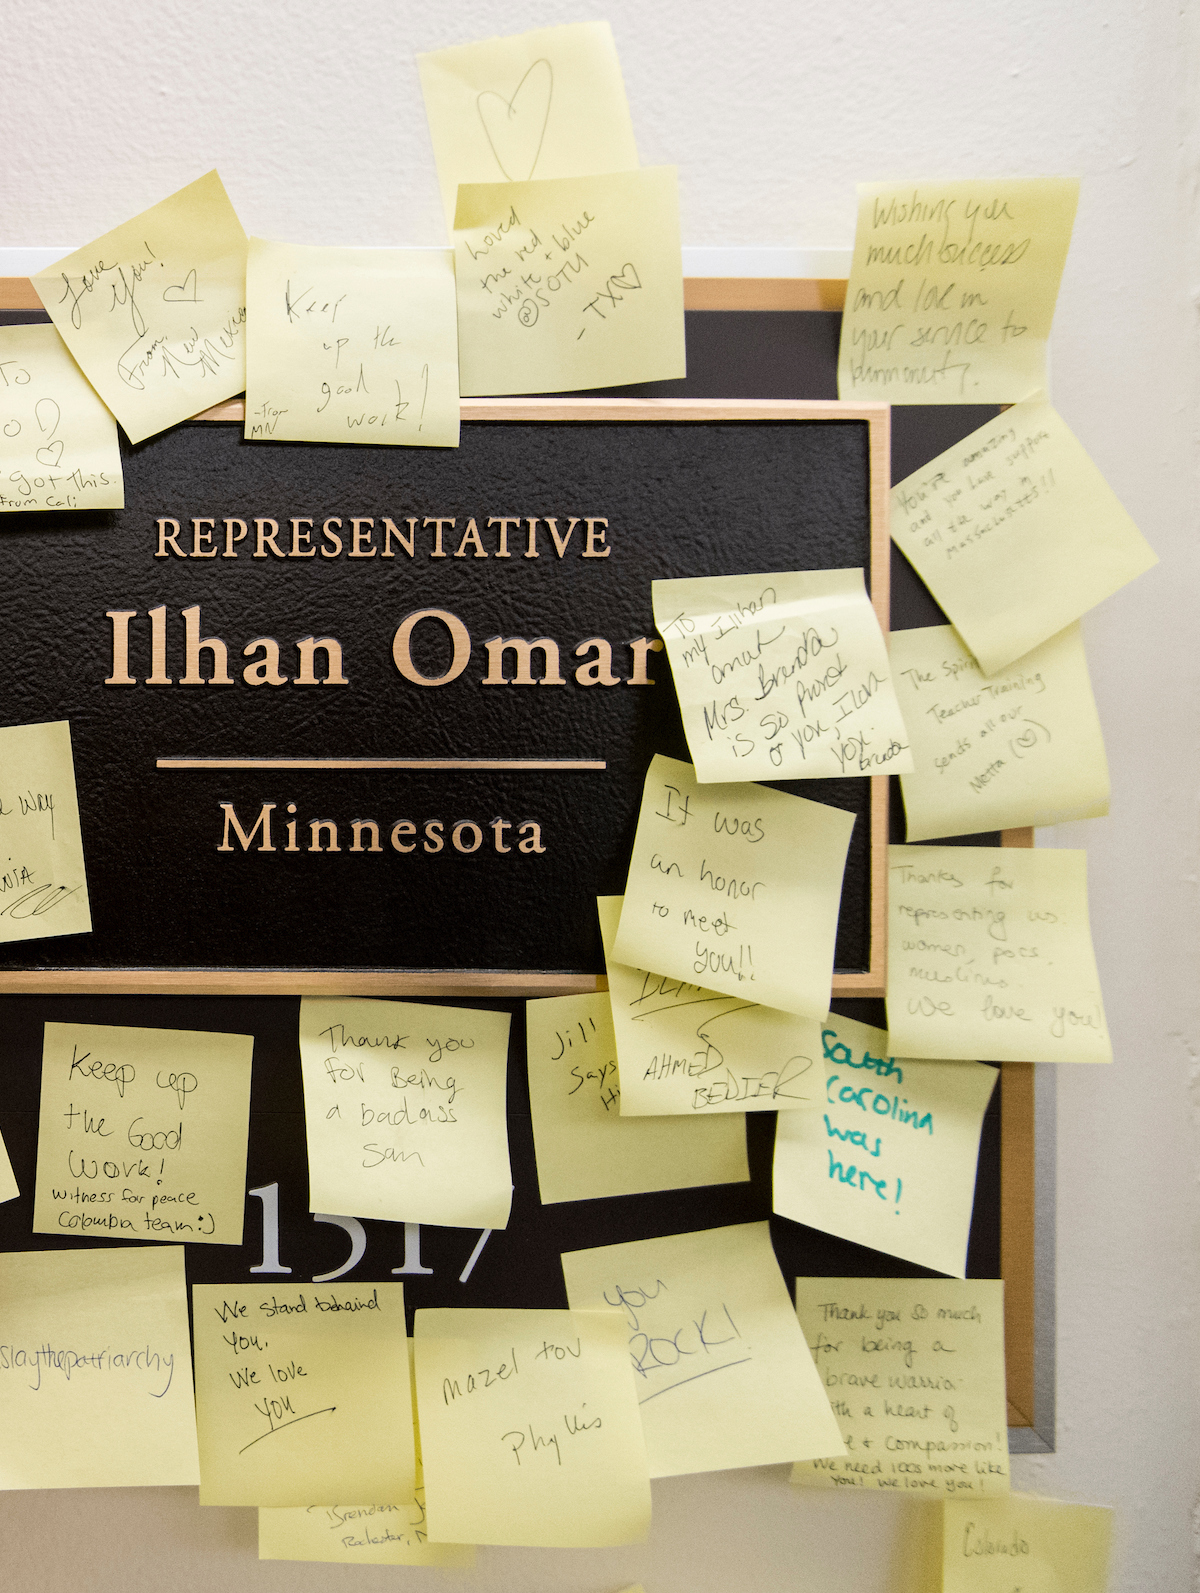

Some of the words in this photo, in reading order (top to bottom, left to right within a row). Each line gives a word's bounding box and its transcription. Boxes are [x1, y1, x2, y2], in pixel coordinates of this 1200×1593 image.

[480, 268, 511, 293] the
[515, 229, 542, 261] red
[492, 273, 541, 319] white
[552, 211, 595, 251] blue
[867, 233, 933, 266] much
[59, 260, 118, 329] Love
[285, 279, 347, 323] Keep
[518, 253, 589, 327] @SOTU
[853, 279, 904, 312] and
[323, 338, 349, 369] up
[374, 325, 401, 349] the
[852, 324, 904, 366] your
[910, 319, 988, 347] service
[1002, 309, 1028, 342] to
[317, 363, 369, 412] good
[9, 471, 62, 495] got
[155, 517, 611, 558] REPRESENTATIVE
[104, 605, 350, 686] Ilhan
[393, 608, 664, 686] Omar
[901, 667, 936, 690] The
[981, 720, 995, 738] all
[1001, 705, 1023, 722] our
[727, 732, 755, 758] is
[217, 801, 547, 854] Minnesota
[655, 785, 694, 826] It
[714, 812, 765, 843] was
[650, 853, 683, 877] an
[700, 859, 766, 900] honor
[891, 865, 963, 887] Thanks
[985, 866, 1013, 896] for
[651, 902, 669, 917] to
[684, 909, 737, 936] meet
[898, 905, 1007, 941] representing
[981, 994, 1032, 1021] love
[319, 1024, 410, 1053] Thank
[427, 1037, 475, 1062] you
[551, 1017, 596, 1060] Jill
[69, 1044, 136, 1098] Keep
[156, 1071, 198, 1110] up
[644, 1040, 724, 1081] AHMED
[692, 1056, 813, 1110] BEDIER
[64, 1103, 114, 1137] the
[326, 1104, 342, 1119] a
[826, 1075, 933, 1135] Carolina
[823, 1113, 883, 1157] was
[122, 1187, 144, 1203] for
[152, 1191, 200, 1210] peace
[828, 1149, 902, 1215] here!
[214, 1300, 249, 1323] We
[259, 1294, 307, 1317] stand
[818, 1302, 872, 1321] Thank
[876, 1309, 900, 1330] you
[937, 1305, 981, 1324] much
[535, 1337, 581, 1360] tov
[809, 1332, 843, 1364] for
[861, 1335, 918, 1368] being
[933, 1340, 957, 1353] a
[229, 1367, 261, 1389] We
[269, 1361, 308, 1383] love
[825, 1366, 881, 1389] brave
[863, 1406, 874, 1417] a
[884, 1400, 934, 1417] heart
[943, 1405, 959, 1432] of
[843, 1459, 883, 1474] need
[929, 1462, 968, 1475] more
[974, 1459, 1007, 1475] like
[904, 1476, 936, 1489] love
